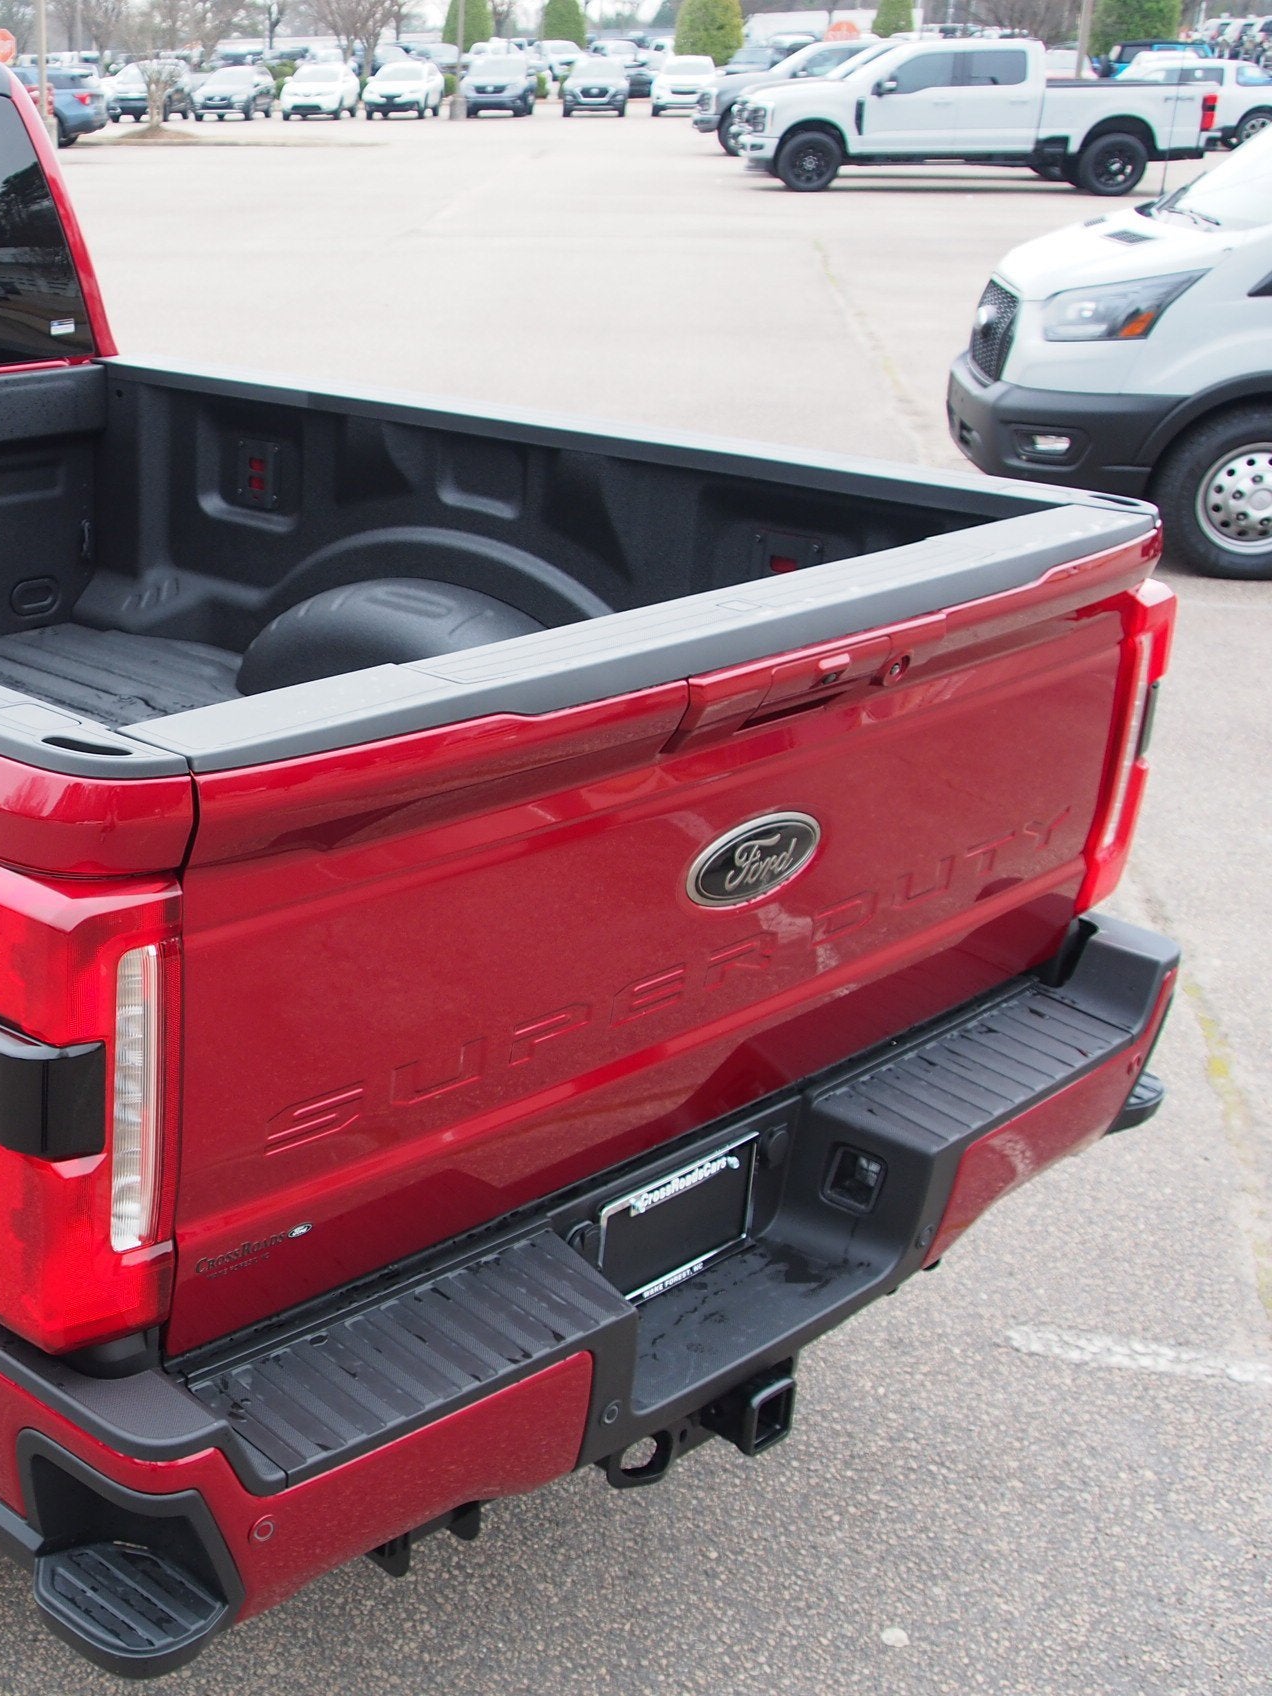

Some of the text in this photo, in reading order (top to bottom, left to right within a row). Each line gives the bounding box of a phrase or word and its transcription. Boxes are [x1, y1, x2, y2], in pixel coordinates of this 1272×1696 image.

[724, 832, 798, 893] Ford
[264, 805, 1072, 1157] SUPER DUTY
[641, 1283, 664, 1299] WAKE
[693, 1262, 704, 1274] NC
